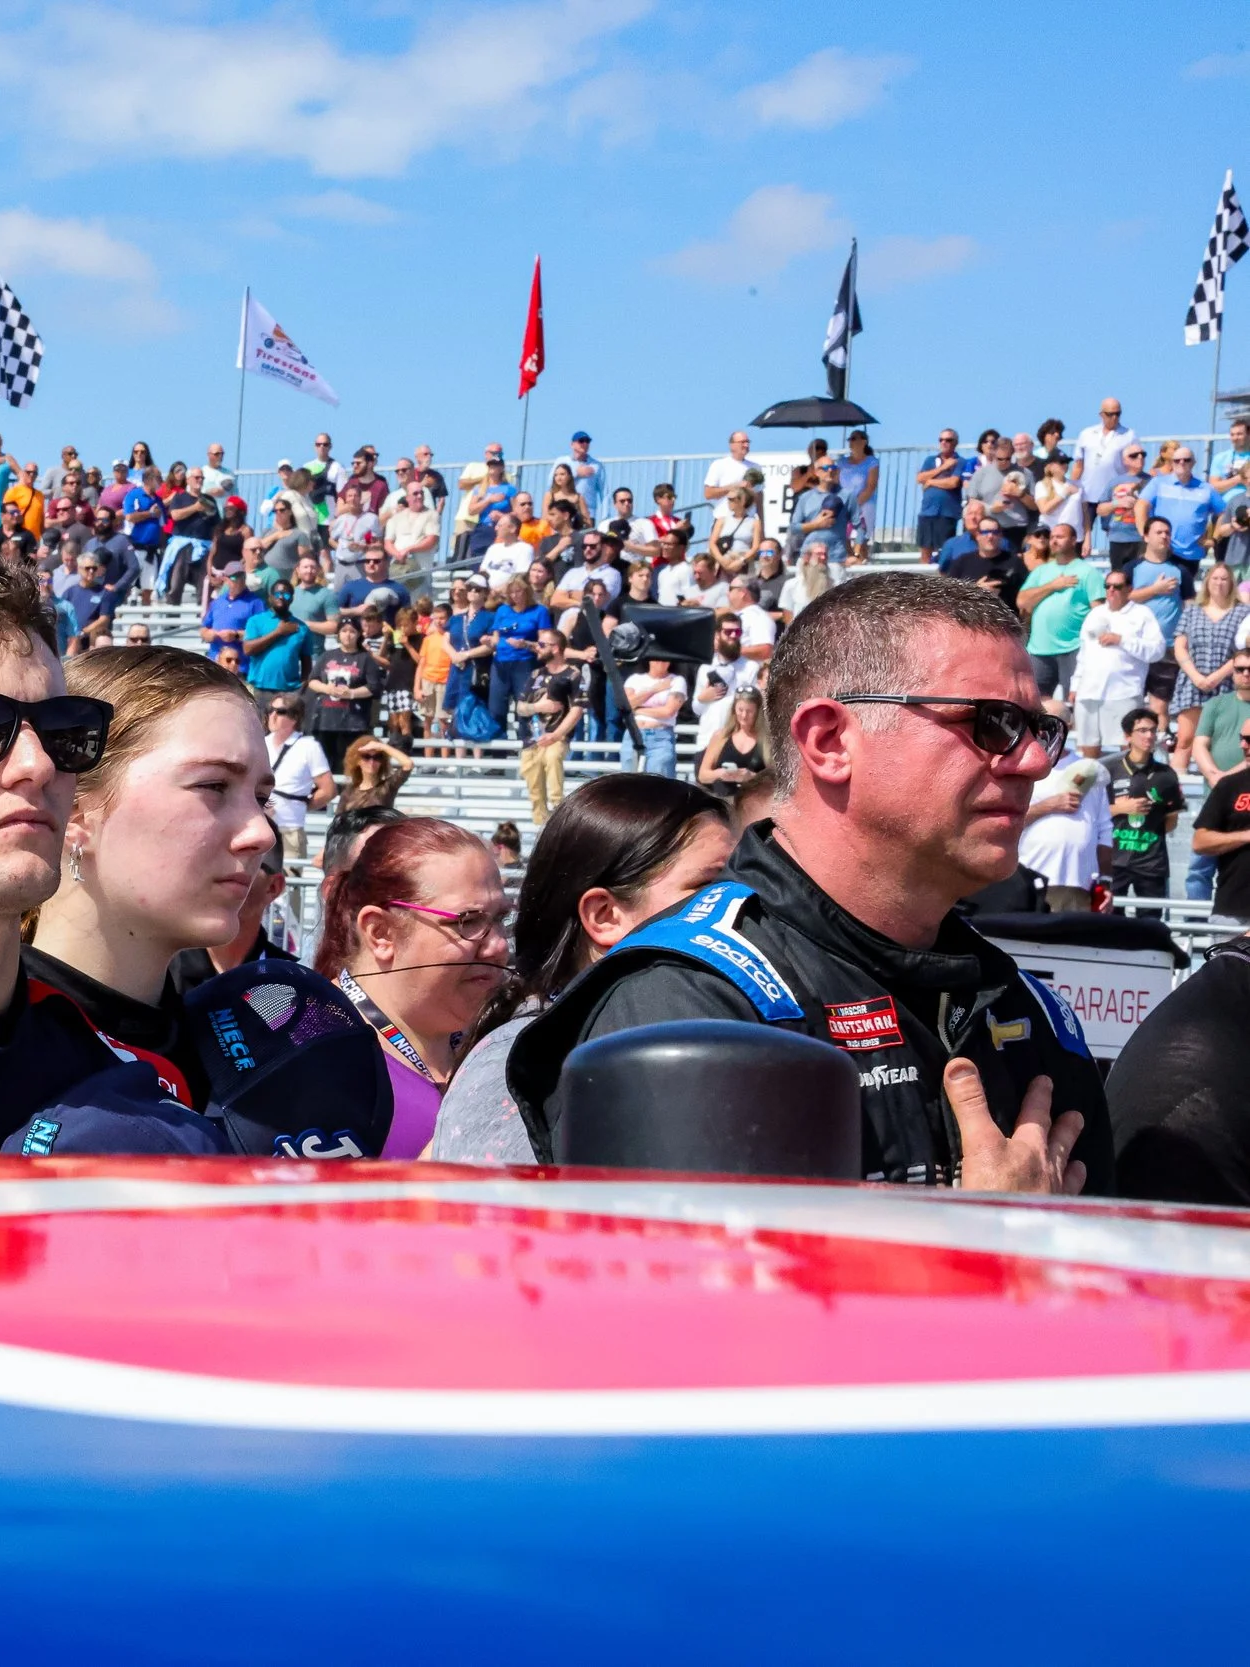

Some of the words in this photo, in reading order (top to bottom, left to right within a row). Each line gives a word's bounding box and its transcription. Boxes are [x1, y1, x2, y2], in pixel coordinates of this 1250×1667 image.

[256, 348, 317, 381] Firestone
[689, 934, 782, 1004] sparco
[840, 1004, 868, 1017] NASCAR
[829, 1015, 894, 1034] CRAFTSMAN
